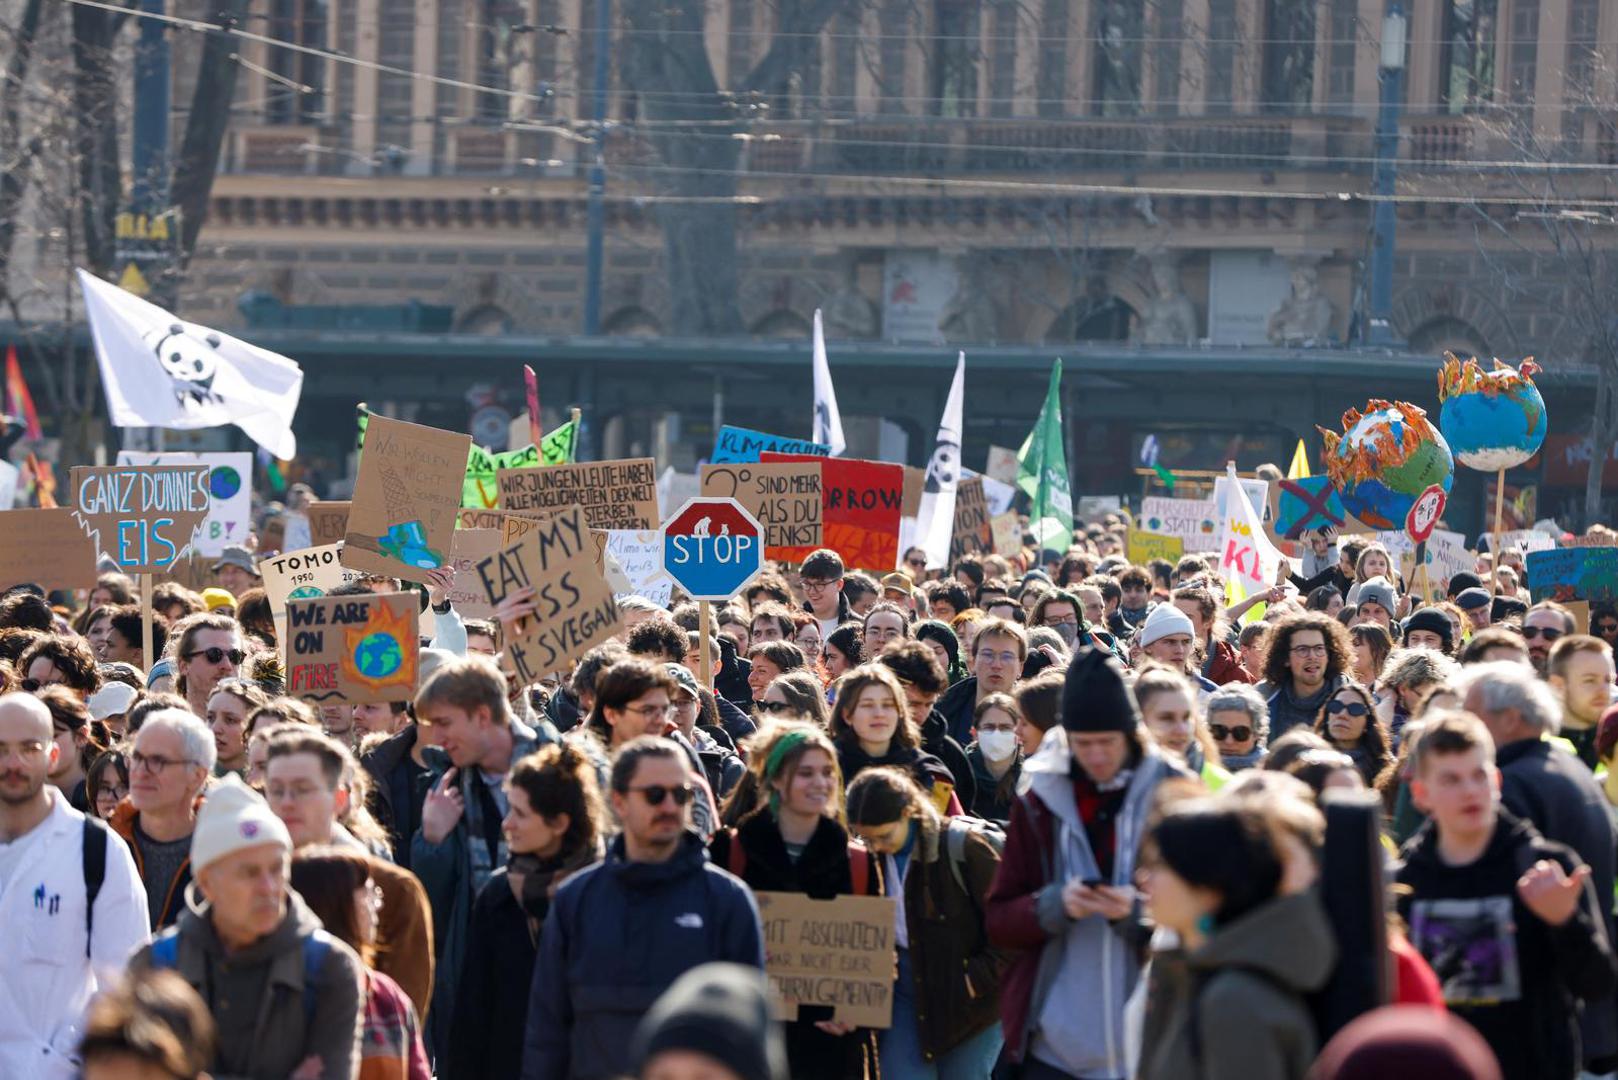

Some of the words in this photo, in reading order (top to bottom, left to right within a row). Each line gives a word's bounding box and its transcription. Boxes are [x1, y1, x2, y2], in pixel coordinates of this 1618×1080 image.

[501, 474, 526, 493] WIR
[528, 468, 580, 492] JUNGEN
[583, 465, 618, 488] LEUTE
[620, 462, 655, 484] HABEN
[756, 475, 787, 494] SIND
[790, 473, 821, 494] MEHR
[79, 474, 138, 514] GANZ
[142, 468, 209, 513] DÜNNES
[505, 494, 530, 511] ALLE
[611, 488, 631, 503] DER
[632, 483, 655, 502] WELT
[584, 504, 636, 522] STERBEN
[756, 499, 788, 524] ALS
[794, 499, 818, 522] DU
[1165, 517, 1199, 534] STATT
[117, 517, 176, 567] EIS
[673, 533, 751, 564] STOP
[476, 543, 531, 608] EAT
[539, 510, 583, 570] MY
[290, 572, 314, 587] 1950
[290, 603, 326, 628] WE
[331, 603, 370, 625] ARE
[550, 594, 619, 653] VEGAN
[294, 631, 324, 654] ON
